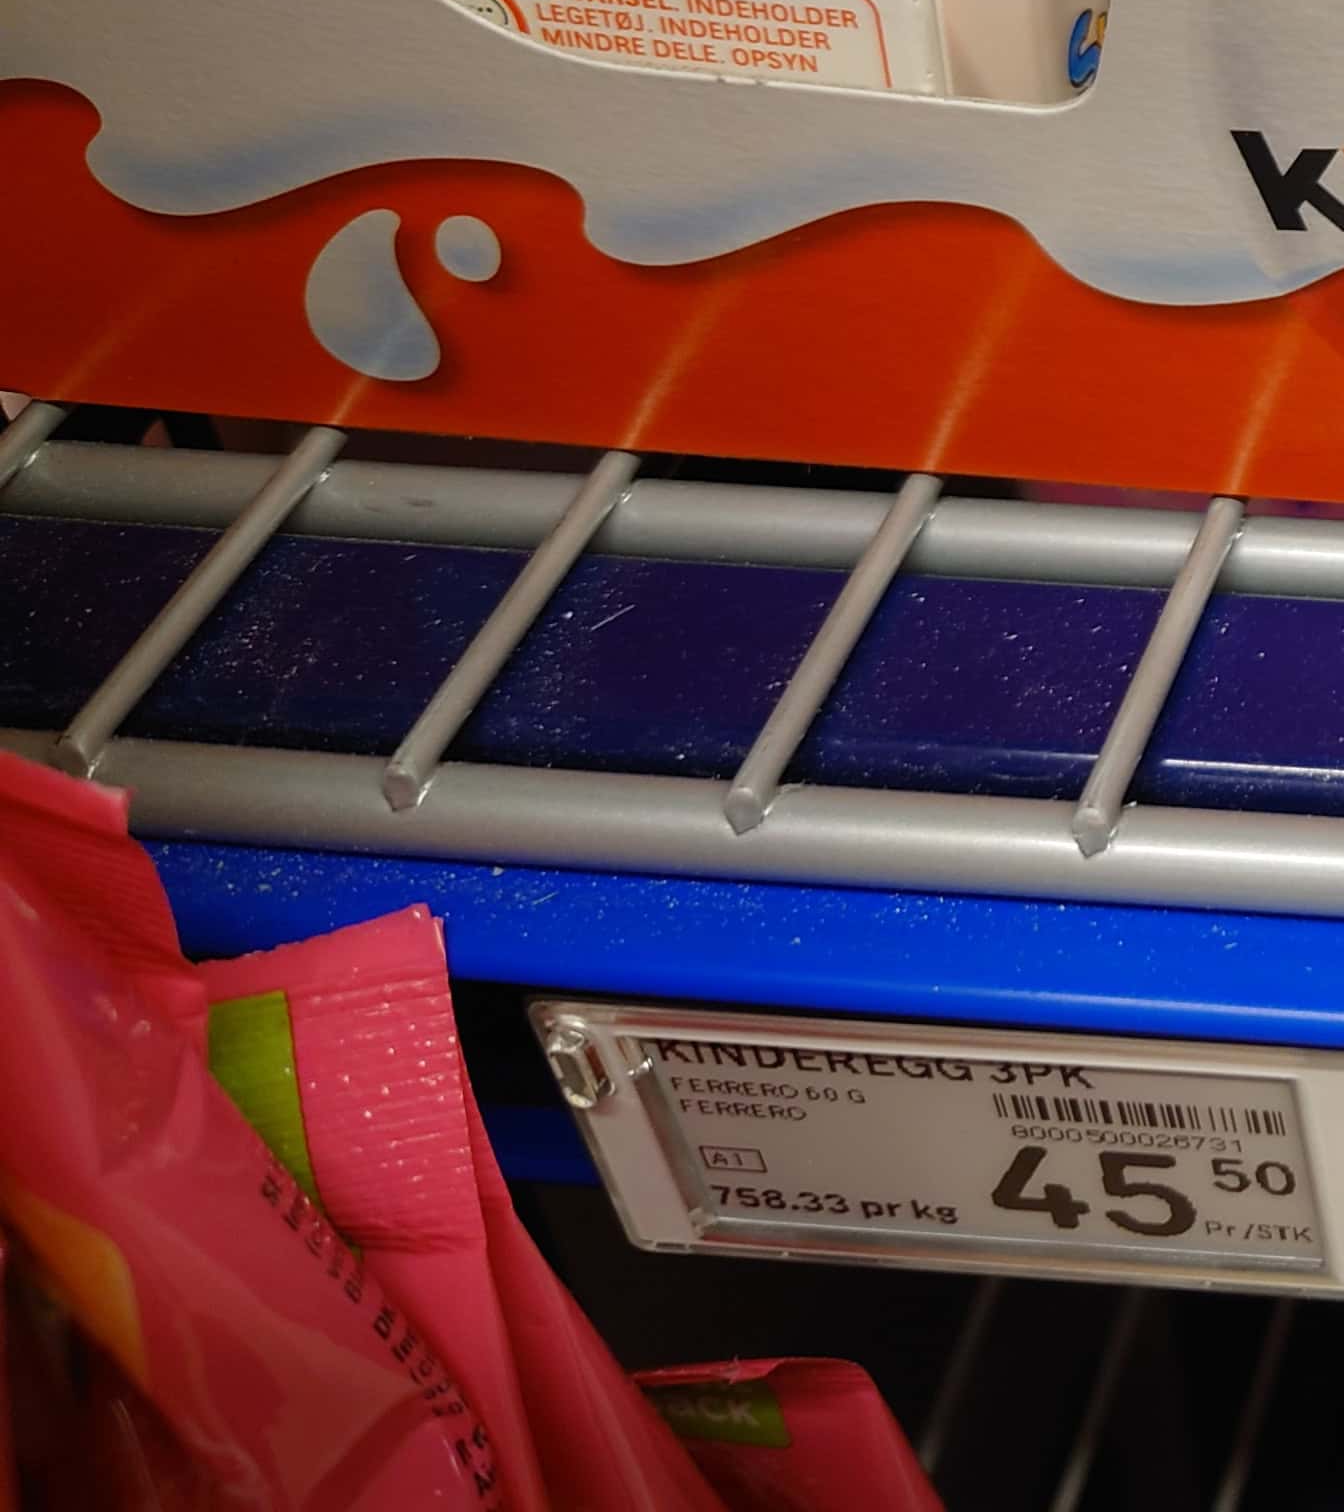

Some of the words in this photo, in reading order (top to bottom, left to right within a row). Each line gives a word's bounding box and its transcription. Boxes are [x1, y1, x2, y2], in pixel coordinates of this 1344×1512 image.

[535, 4, 653, 35] LEGETØJ.
[660, 18, 832, 51] INDEHOLDER
[541, 28, 649, 57] MINDRE
[653, 41, 726, 65] DELE.
[732, 47, 819, 73] OPSYN
[670, 1076, 799, 1100] FERRERO
[679, 1098, 807, 1121] FERRERO
[1010, 1125, 1244, 1153] 8000500026731
[711, 1185, 850, 1215] 758.33
[861, 1200, 900, 1220] pr
[911, 1199, 958, 1225] kg
[991, 1144, 1198, 1238] 45
[1211, 1158, 1297, 1197] 50
